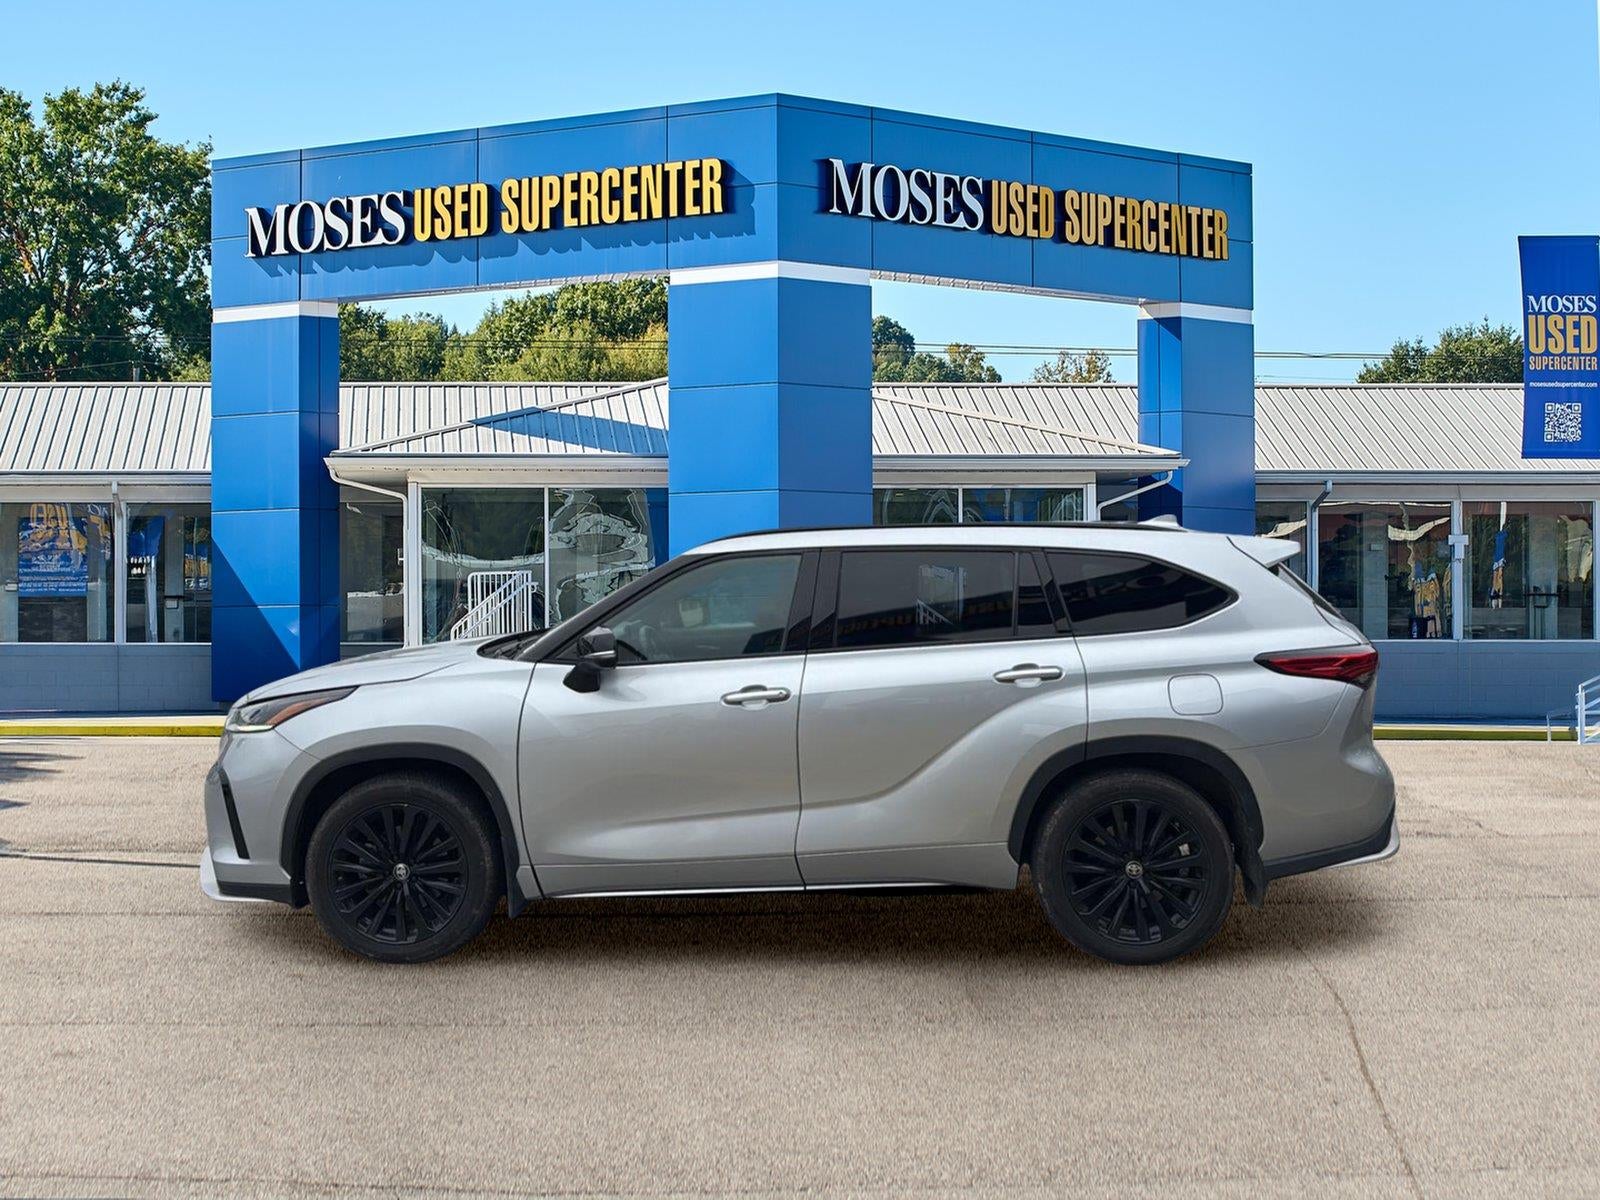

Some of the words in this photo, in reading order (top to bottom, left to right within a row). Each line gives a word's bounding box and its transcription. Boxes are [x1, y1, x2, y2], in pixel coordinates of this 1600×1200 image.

[243, 191, 407, 258] MOSES
[413, 182, 489, 242] USED
[500, 157, 724, 234] SUPERCENTER
[828, 158, 984, 230] MOSES
[991, 179, 1055, 240] USED
[1065, 189, 1229, 260] SUPERCENTER
[1528, 295, 1597, 313] MOSES
[1528, 315, 1597, 354] USED
[1529, 356, 1598, 371] SUPERCENTER
